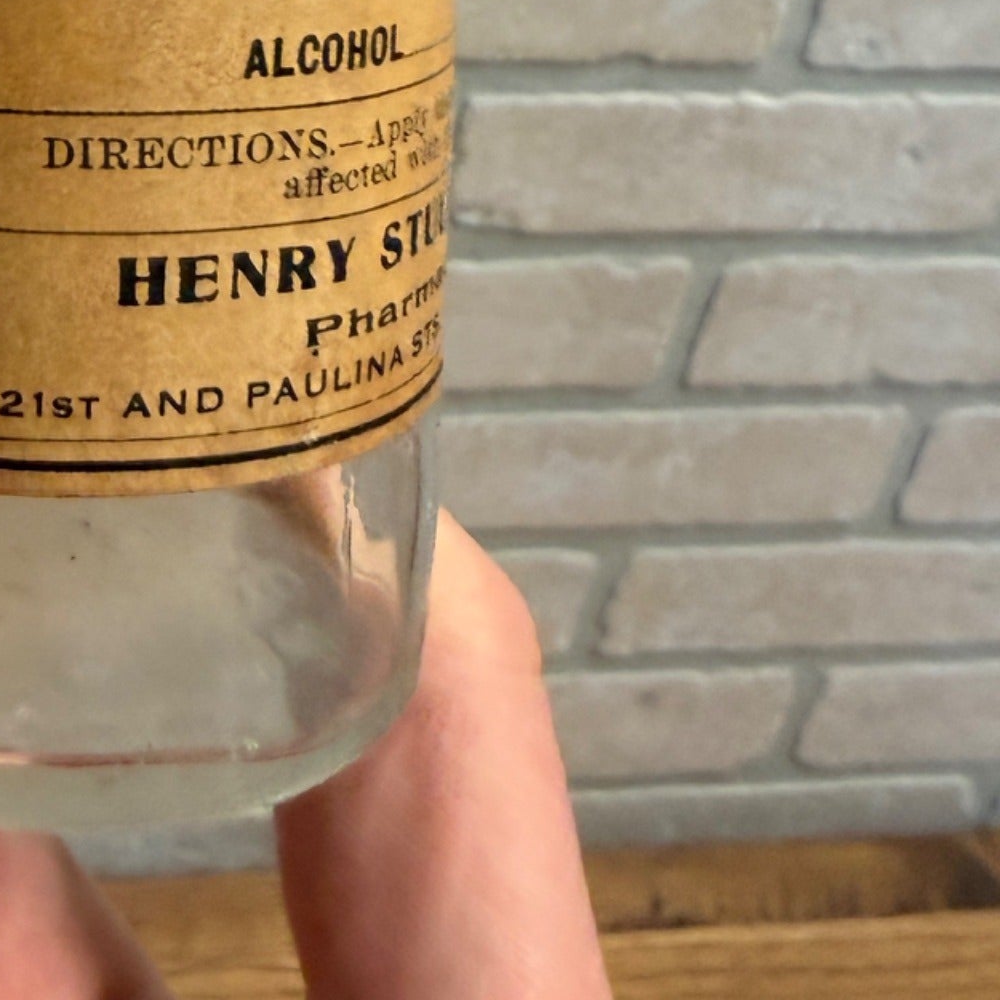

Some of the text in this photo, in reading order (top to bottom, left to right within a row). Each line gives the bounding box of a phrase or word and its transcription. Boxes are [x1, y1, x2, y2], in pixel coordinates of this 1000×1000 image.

[243, 23, 404, 80] ALCOHOL
[283, 150, 398, 200] affected
[117, 193, 445, 307] HENRY STU
[122, 386, 225, 419] AND
[246, 344, 404, 409] PAULINA
